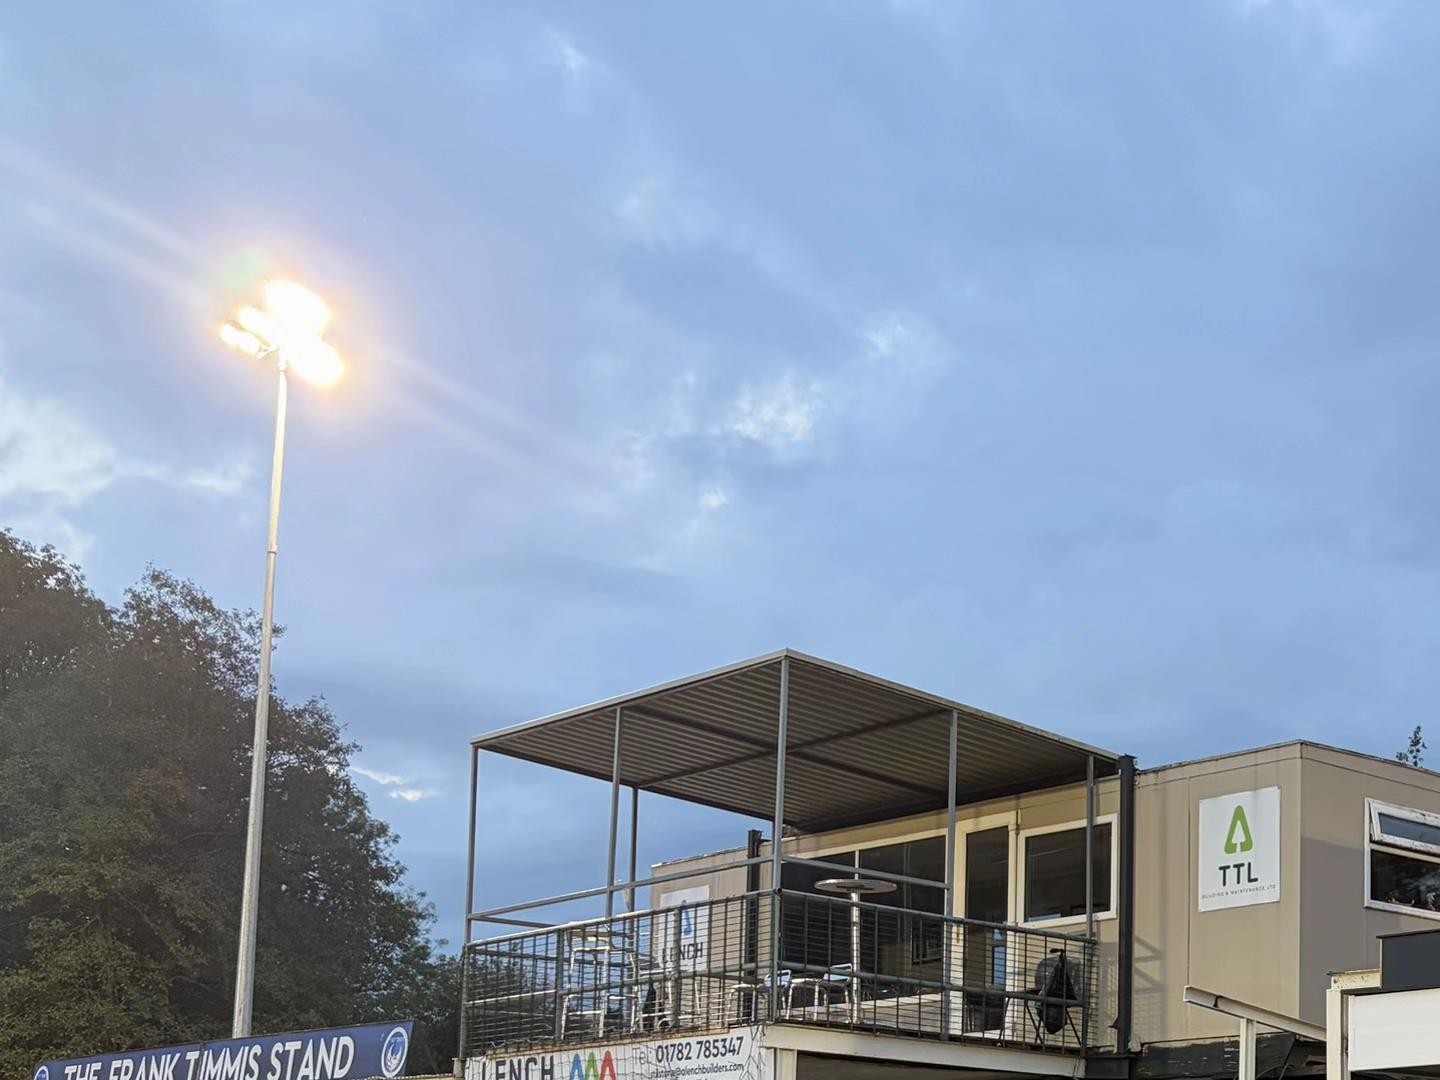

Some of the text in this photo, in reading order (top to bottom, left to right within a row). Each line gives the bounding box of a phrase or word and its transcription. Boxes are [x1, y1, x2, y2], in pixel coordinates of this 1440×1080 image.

[1218, 861, 1259, 887] TTL
[655, 1041, 692, 1063] 01782
[696, 1036, 744, 1059] 785347
